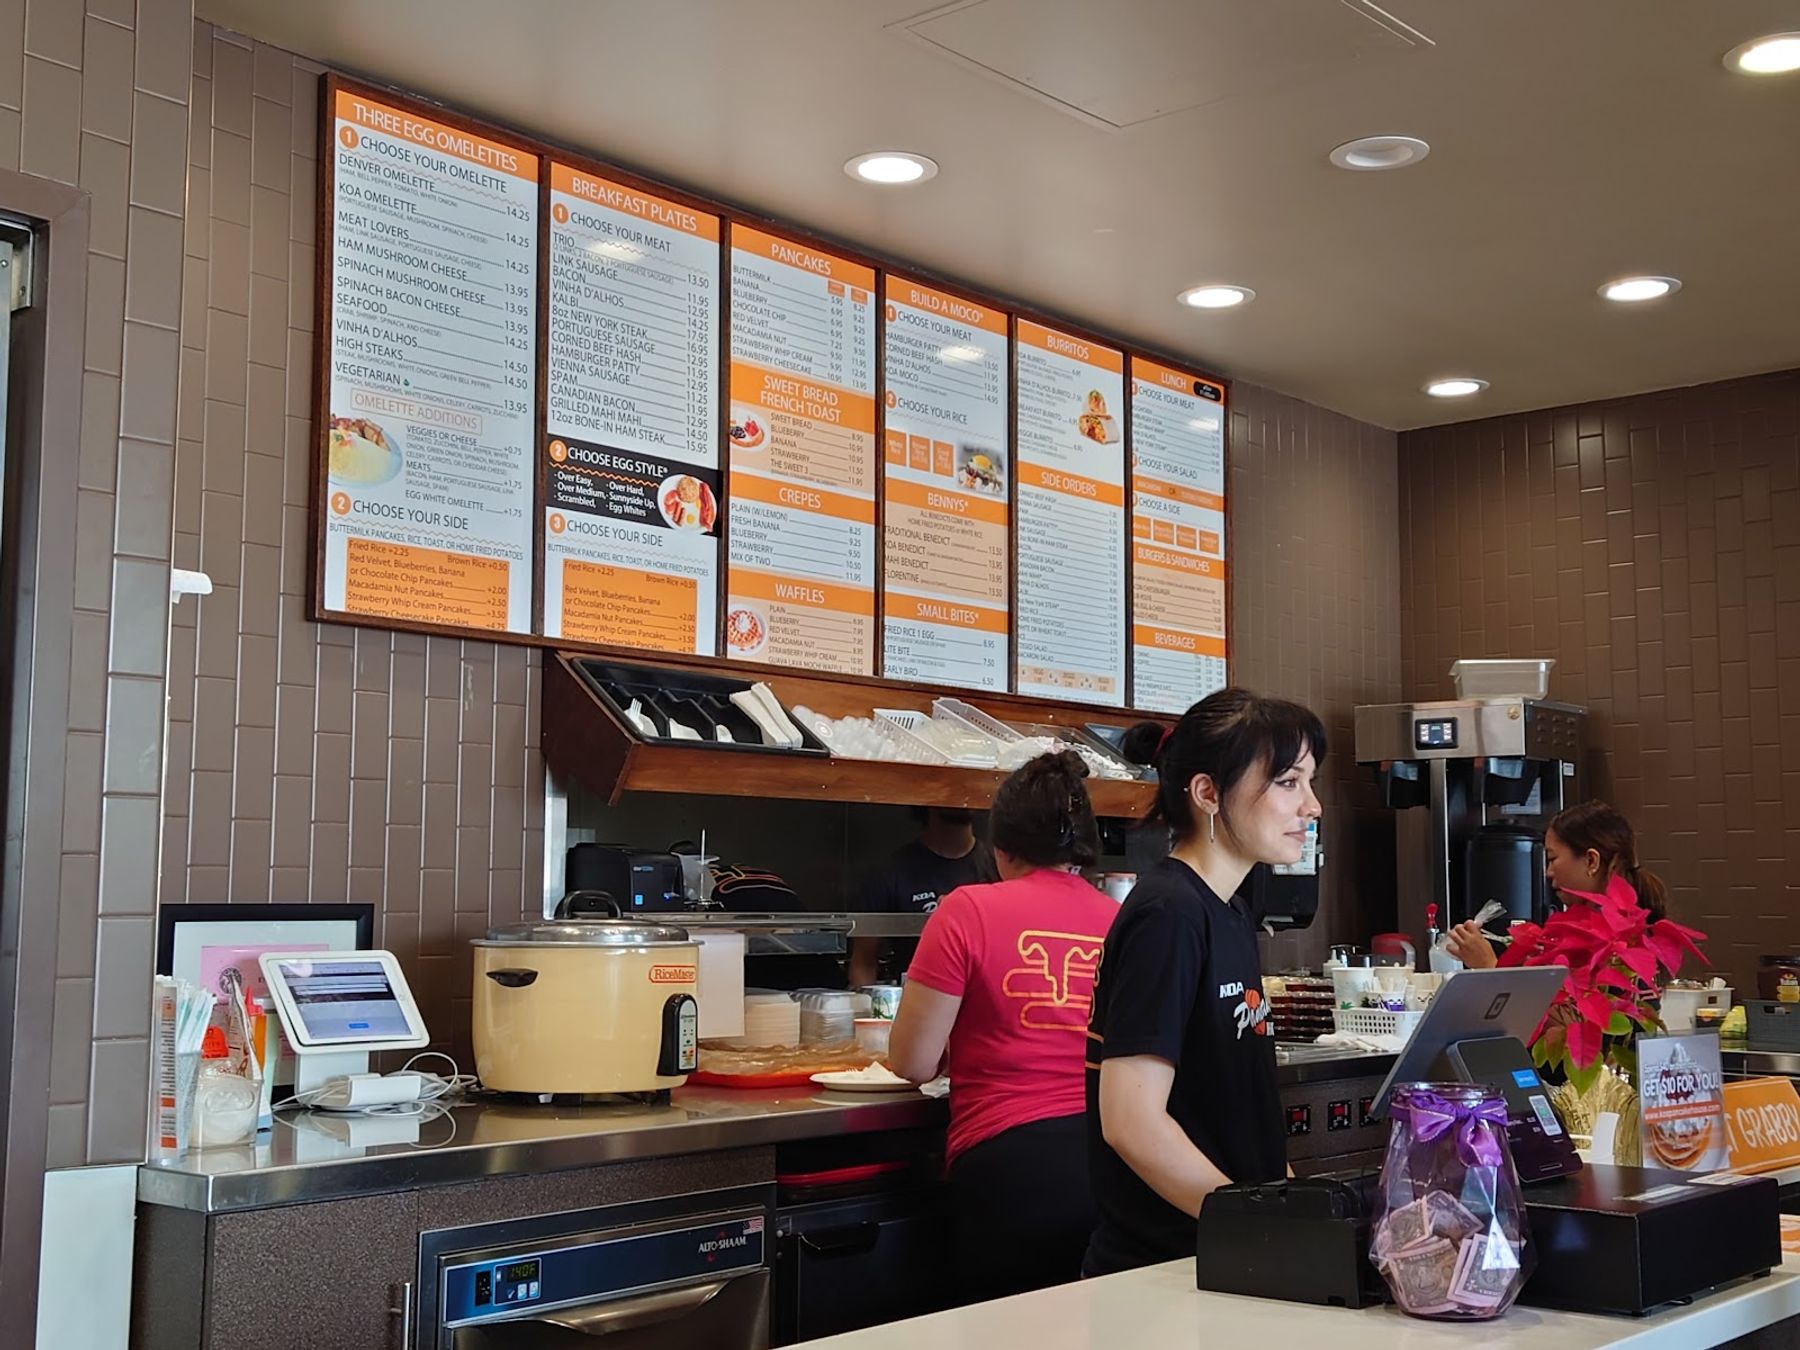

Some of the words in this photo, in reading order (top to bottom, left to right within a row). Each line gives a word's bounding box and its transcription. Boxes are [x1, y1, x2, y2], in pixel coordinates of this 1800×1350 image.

[353, 102, 400, 134] THREE
[404, 121, 433, 145] EGG
[436, 130, 517, 172] OMELETTES
[360, 135, 410, 162] CHOOSE
[414, 152, 446, 174] YOUR
[449, 164, 506, 193] OMELETTE
[339, 153, 380, 176] DENVER
[383, 167, 434, 193] OMELETTE
[506, 205, 529, 222] 14.25
[572, 176, 648, 216] BREAKFAST
[651, 203, 696, 231] PLATES
[338, 181, 361, 198] KOA
[364, 189, 416, 214] OMELETTE
[506, 232, 528, 248] 14.25
[338, 210, 366, 228] MEAT
[370, 219, 409, 240] LOVERS
[505, 258, 528, 274] 14.25
[570, 210, 612, 234] CHOOSE
[615, 225, 642, 244] YOUR
[644, 234, 670, 253] MEAT
[338, 236, 363, 252] HAM
[365, 243, 428, 271] MUSHROOM
[431, 262, 466, 281] CHEESE
[505, 282, 528, 298] 13.95
[553, 231, 574, 248] TRIO
[688, 273, 708, 289] 13.50
[771, 242, 831, 275] PANCAKES
[337, 256, 383, 278] SPINACH
[386, 269, 447, 295] MUSHROOM
[449, 286, 485, 305] CHEESE
[504, 301, 528, 316] 13.95
[552, 265, 585, 284] BACON
[687, 304, 708, 319] 12.95
[553, 252, 573, 267] LINK
[575, 258, 617, 281] SAUSAGE
[687, 292, 708, 307] 11.95
[552, 278, 581, 295] VINHA
[687, 317, 708, 331] 14.25
[911, 289, 938, 310] BUILD
[941, 299, 947, 313] A
[336, 292, 387, 315] SEAFOOD
[504, 335, 527, 350] 14.25
[552, 304, 568, 318] 8oz
[570, 309, 591, 324] NEW
[594, 315, 617, 331] YORK
[620, 322, 647, 339] STEAK
[687, 341, 708, 356] 16.95
[898, 309, 928, 329] CHOOSE
[930, 320, 951, 336] YOUR
[953, 327, 971, 342] MEAT
[336, 318, 368, 336] VINHA
[372, 326, 417, 347] D'ALHOS
[504, 359, 527, 374] 14.50
[551, 330, 591, 350] CORNED
[593, 341, 613, 356] BEEF
[616, 347, 641, 363] HASH
[687, 366, 707, 380] 11.95
[552, 317, 611, 342] PORTUGUESE
[614, 333, 654, 354] SAUSAGE
[687, 353, 707, 368] 12.95
[1047, 334, 1088, 359] BURRITOS
[336, 335, 362, 351] HIGH
[365, 342, 403, 361] STEAKS
[503, 375, 527, 390] 14.50
[551, 343, 610, 368] HAMBURGER
[612, 358, 640, 375] PATTY
[687, 378, 707, 392] 12.95
[551, 356, 585, 374] VIENNA
[588, 365, 629, 385] SAUSAGE
[335, 360, 400, 385] VEGETARIAN
[503, 399, 527, 413] 13.95
[764, 375, 799, 396] SWEET
[803, 385, 837, 405] BREAD
[1160, 371, 1186, 389] LUNCH
[354, 392, 414, 416] OMELETTE
[417, 406, 477, 429] ADDITIONS
[551, 382, 600, 404] CANADIAN
[603, 395, 635, 412] BACON
[551, 395, 588, 414] GRILLED
[591, 405, 615, 420] MAHI
[618, 411, 641, 426] MAHI
[760, 390, 804, 413] FRENCH
[807, 402, 840, 422] TOAST
[898, 397, 928, 414] CHOOSE
[930, 406, 951, 420] YOUR
[953, 412, 967, 425] RICE
[551, 409, 572, 424] 12oz
[575, 414, 612, 432] BONE-IN
[615, 423, 636, 438] HAM
[639, 429, 664, 444] STEAK
[406, 460, 430, 472] MEATS
[568, 446, 610, 466] CHOOSE
[613, 456, 633, 471] EGG
[557, 471, 574, 481] Over
[557, 482, 573, 492] Over
[609, 481, 623, 491] Over
[1041, 471, 1059, 487] SIDE
[1062, 476, 1096, 496] ORDERS
[405, 489, 421, 500] EGG
[423, 492, 445, 504] WHITE
[447, 497, 483, 511] OMELETTE
[609, 502, 622, 513] Egg
[623, 504, 646, 516] Whites
[779, 486, 820, 508] CREPES
[352, 499, 403, 520] CHOOSE
[407, 508, 440, 526] YOUR
[443, 514, 468, 530] SIDE
[567, 519, 609, 537] CHOOSE
[612, 527, 639, 542] YOUR
[642, 533, 662, 546] SIDE
[775, 583, 824, 603] WAFFLES
[917, 602, 947, 619] SMALL
[1155, 632, 1195, 649] BEVERAGES
[1643, 1079, 1659, 1097] GET
[1677, 1074, 1695, 1094] FOR
[1695, 1072, 1719, 1091] YOU!
[1736, 1103, 1800, 1148] GRABBY
[698, 1236, 747, 1253] ALTO-SHAAM
